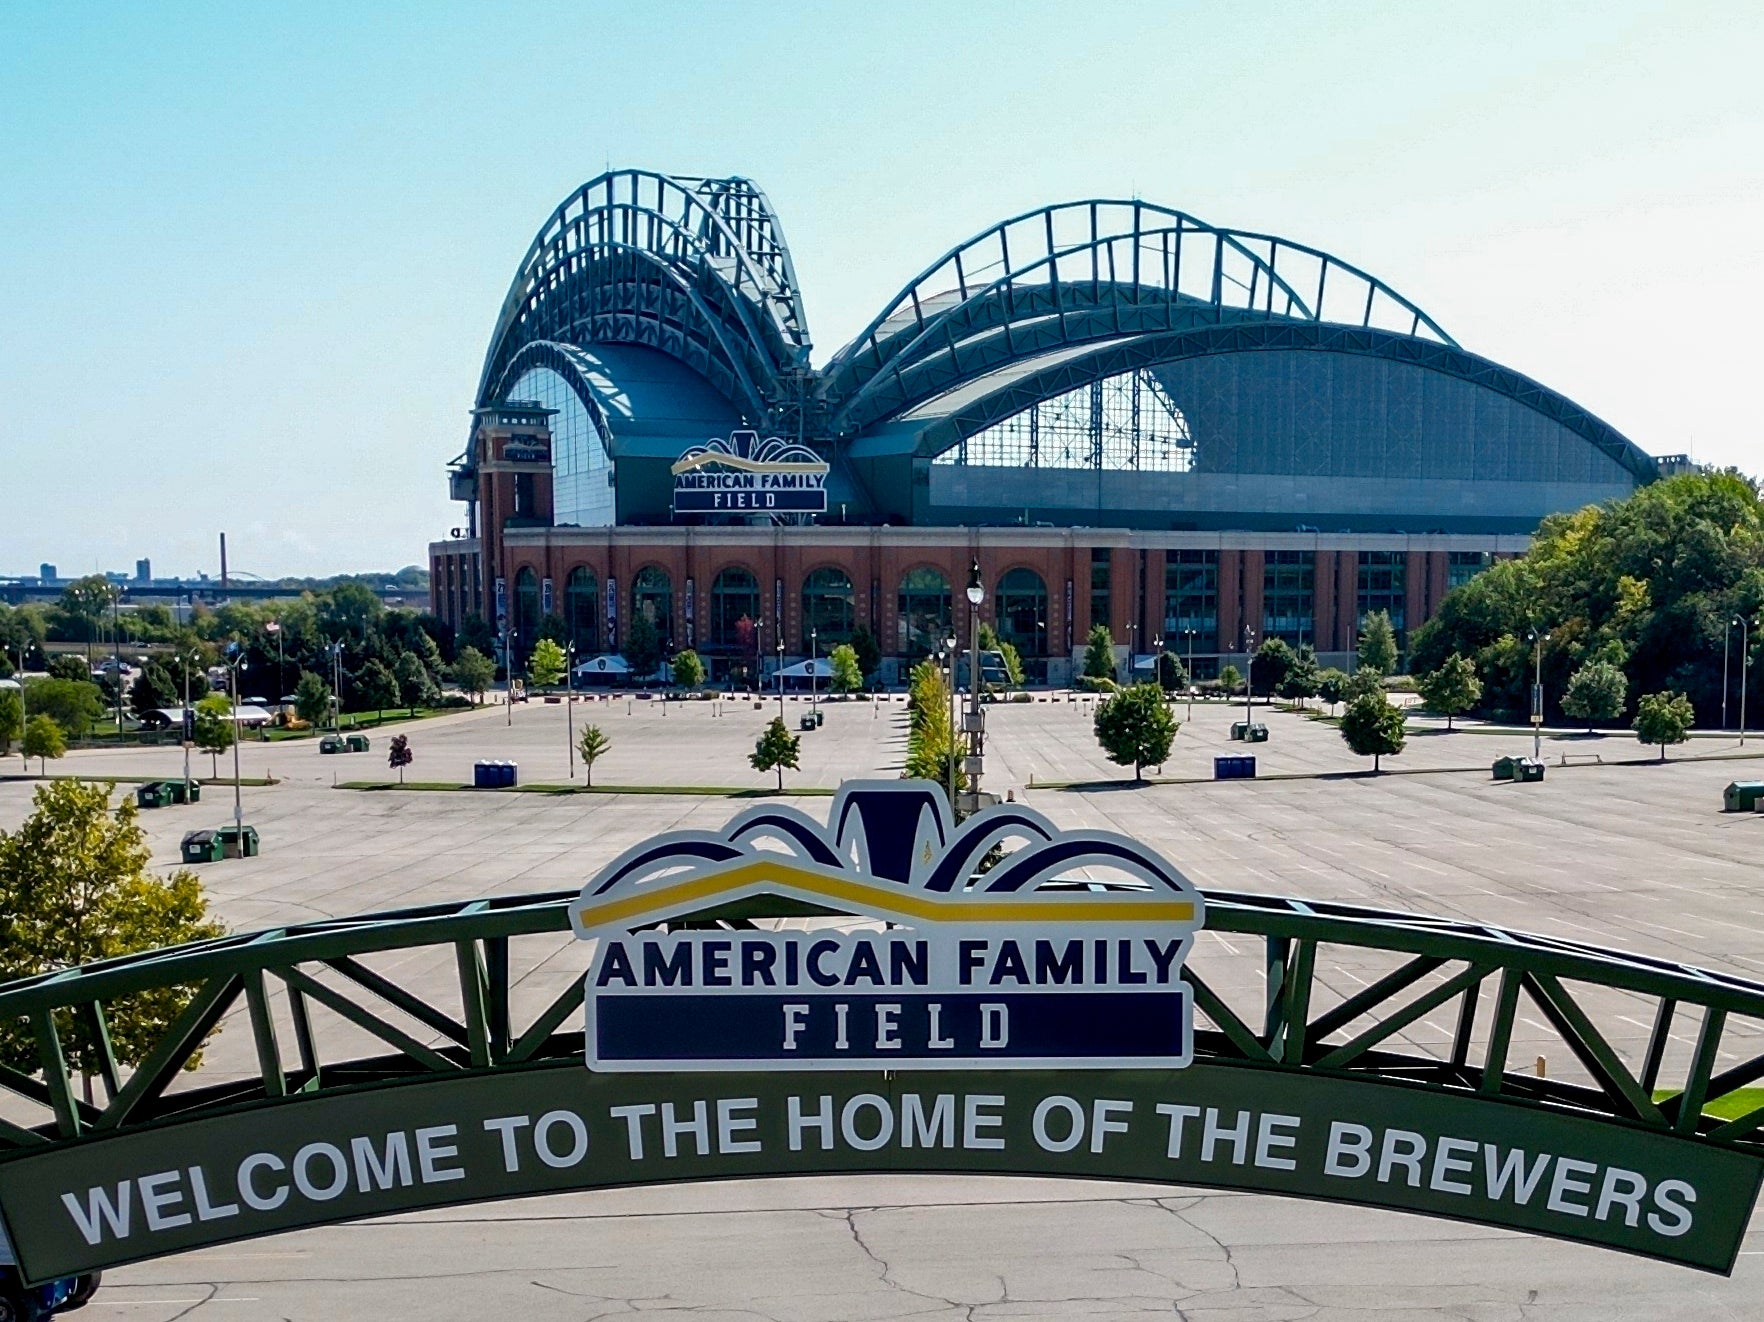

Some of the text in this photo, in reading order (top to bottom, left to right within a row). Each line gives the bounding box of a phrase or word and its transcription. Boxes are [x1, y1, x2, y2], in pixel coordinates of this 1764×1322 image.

[675, 474, 824, 489] AMERICAN FAMILY
[714, 493, 776, 507] FIELD
[599, 939, 1184, 987] AMERICAN FAMILY
[783, 1003, 1009, 1050] FIELD
[61, 1093, 1697, 1246] WELCOME TO THE HOME OF THE BREWERS
